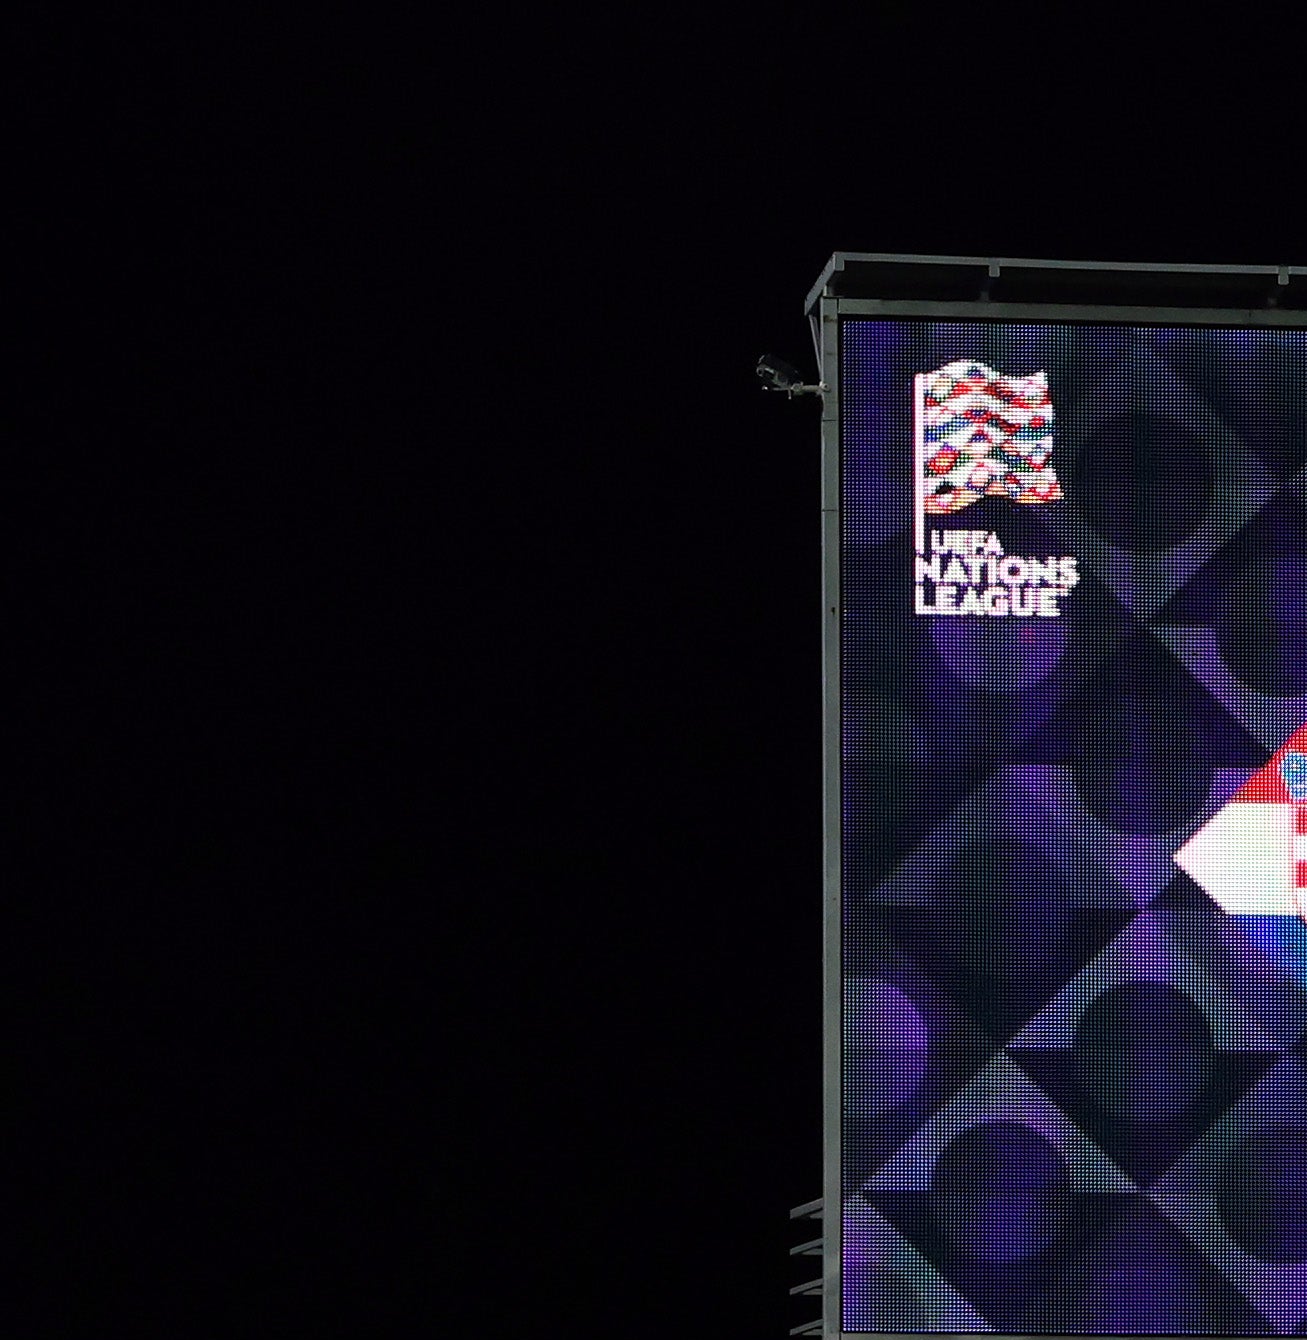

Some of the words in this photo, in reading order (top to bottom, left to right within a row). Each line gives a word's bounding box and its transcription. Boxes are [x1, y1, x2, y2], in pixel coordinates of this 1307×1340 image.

[931, 530, 1003, 555] UEFA
[915, 555, 1080, 585] NATIONS
[915, 584, 1069, 616] LEAGUE
